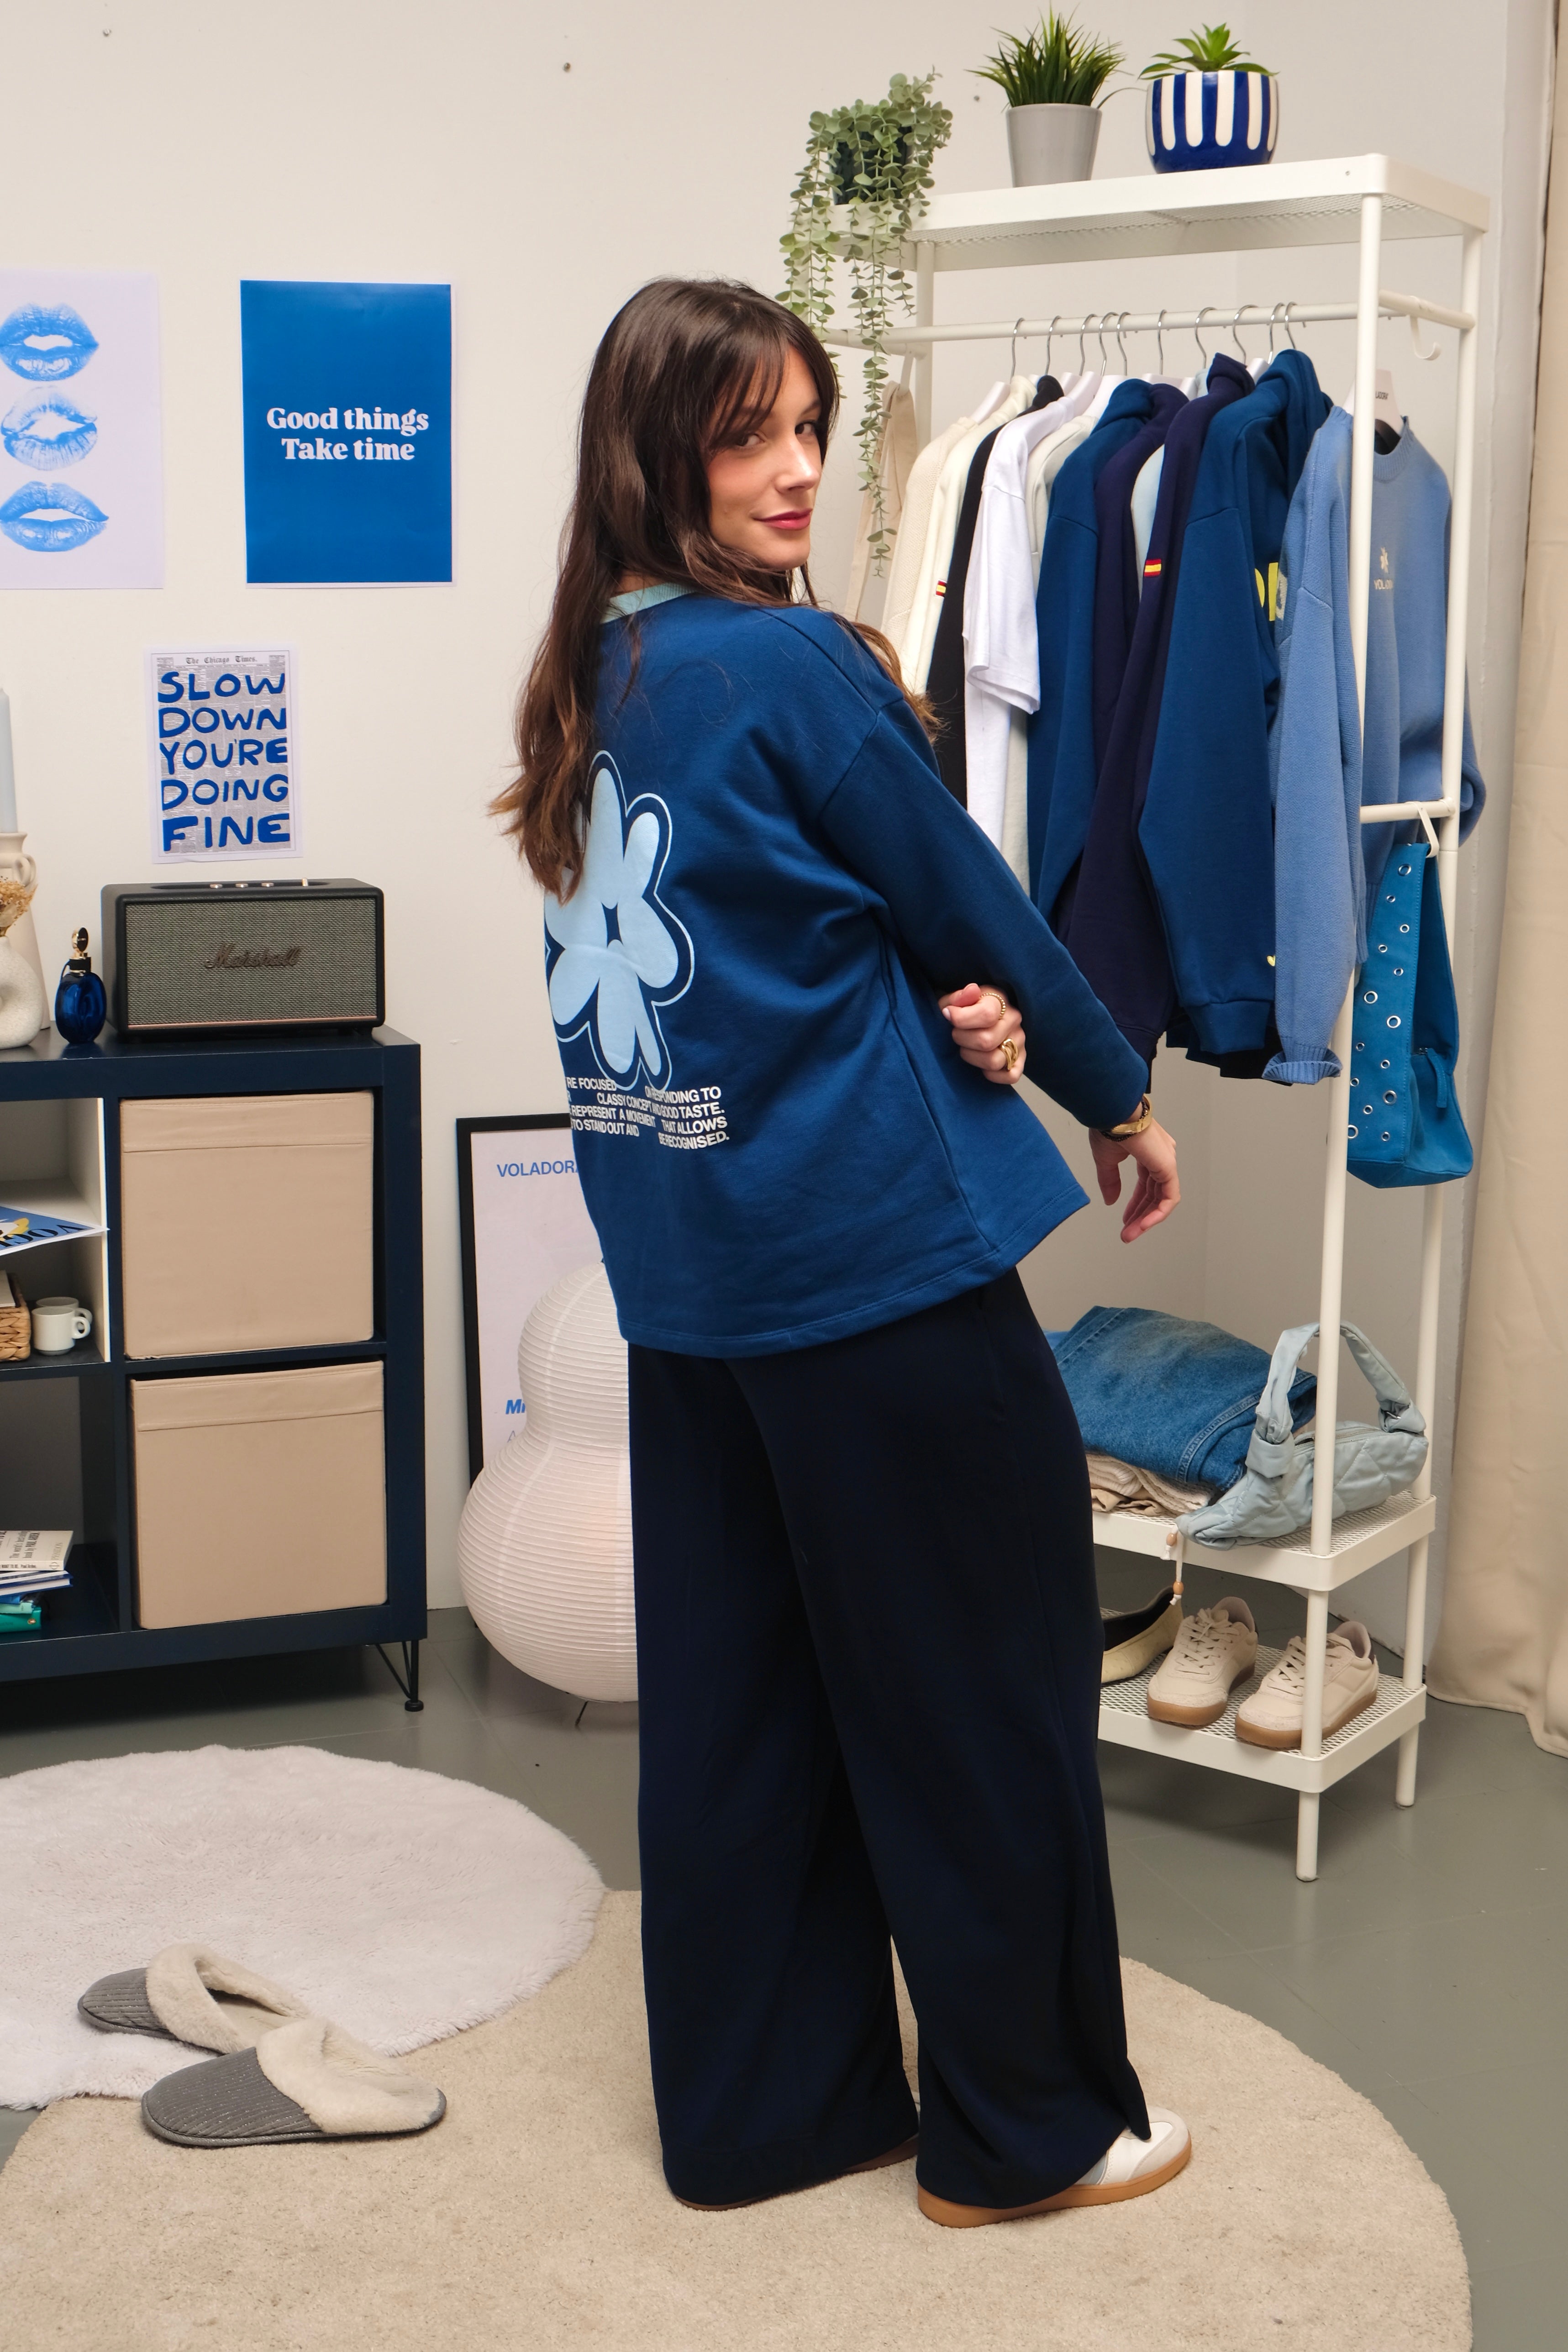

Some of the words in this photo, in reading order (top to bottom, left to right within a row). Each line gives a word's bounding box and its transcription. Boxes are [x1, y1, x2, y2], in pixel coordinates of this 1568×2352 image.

[267, 407, 337, 430] Good
[343, 407, 429, 436] things
[281, 437, 348, 460] Take
[353, 437, 415, 460] time
[158, 671, 285, 703] SLOW
[158, 707, 287, 738] DOWN
[160, 737, 288, 775] YOU'RE
[161, 774, 289, 811] DOING
[163, 813, 290, 852] FINE
[205, 942, 300, 968] Marshall
[566, 1077, 578, 1089] RE
[578, 1078, 617, 1091] FOCUSED
[700, 1086, 721, 1100] TO
[571, 1105, 616, 1120] REPRESENT
[619, 1108, 626, 1120] A
[626, 1109, 656, 1127] MOVEMENT
[661, 1119, 676, 1133] THAT
[677, 1116, 727, 1134] ALLOWS
[597, 1092, 626, 1106] CLASSY
[626, 1095, 652, 1112] CONCEPT
[660, 1105, 679, 1119] GOOD
[678, 1102, 725, 1119] TASTE.
[572, 1119, 584, 1131] TO
[584, 1119, 607, 1133] STAND
[607, 1122, 625, 1135] OUT
[626, 1124, 639, 1137] AND
[664, 1131, 730, 1149] RECOGNISED.
[497, 1160, 578, 1177] VOLADOR
